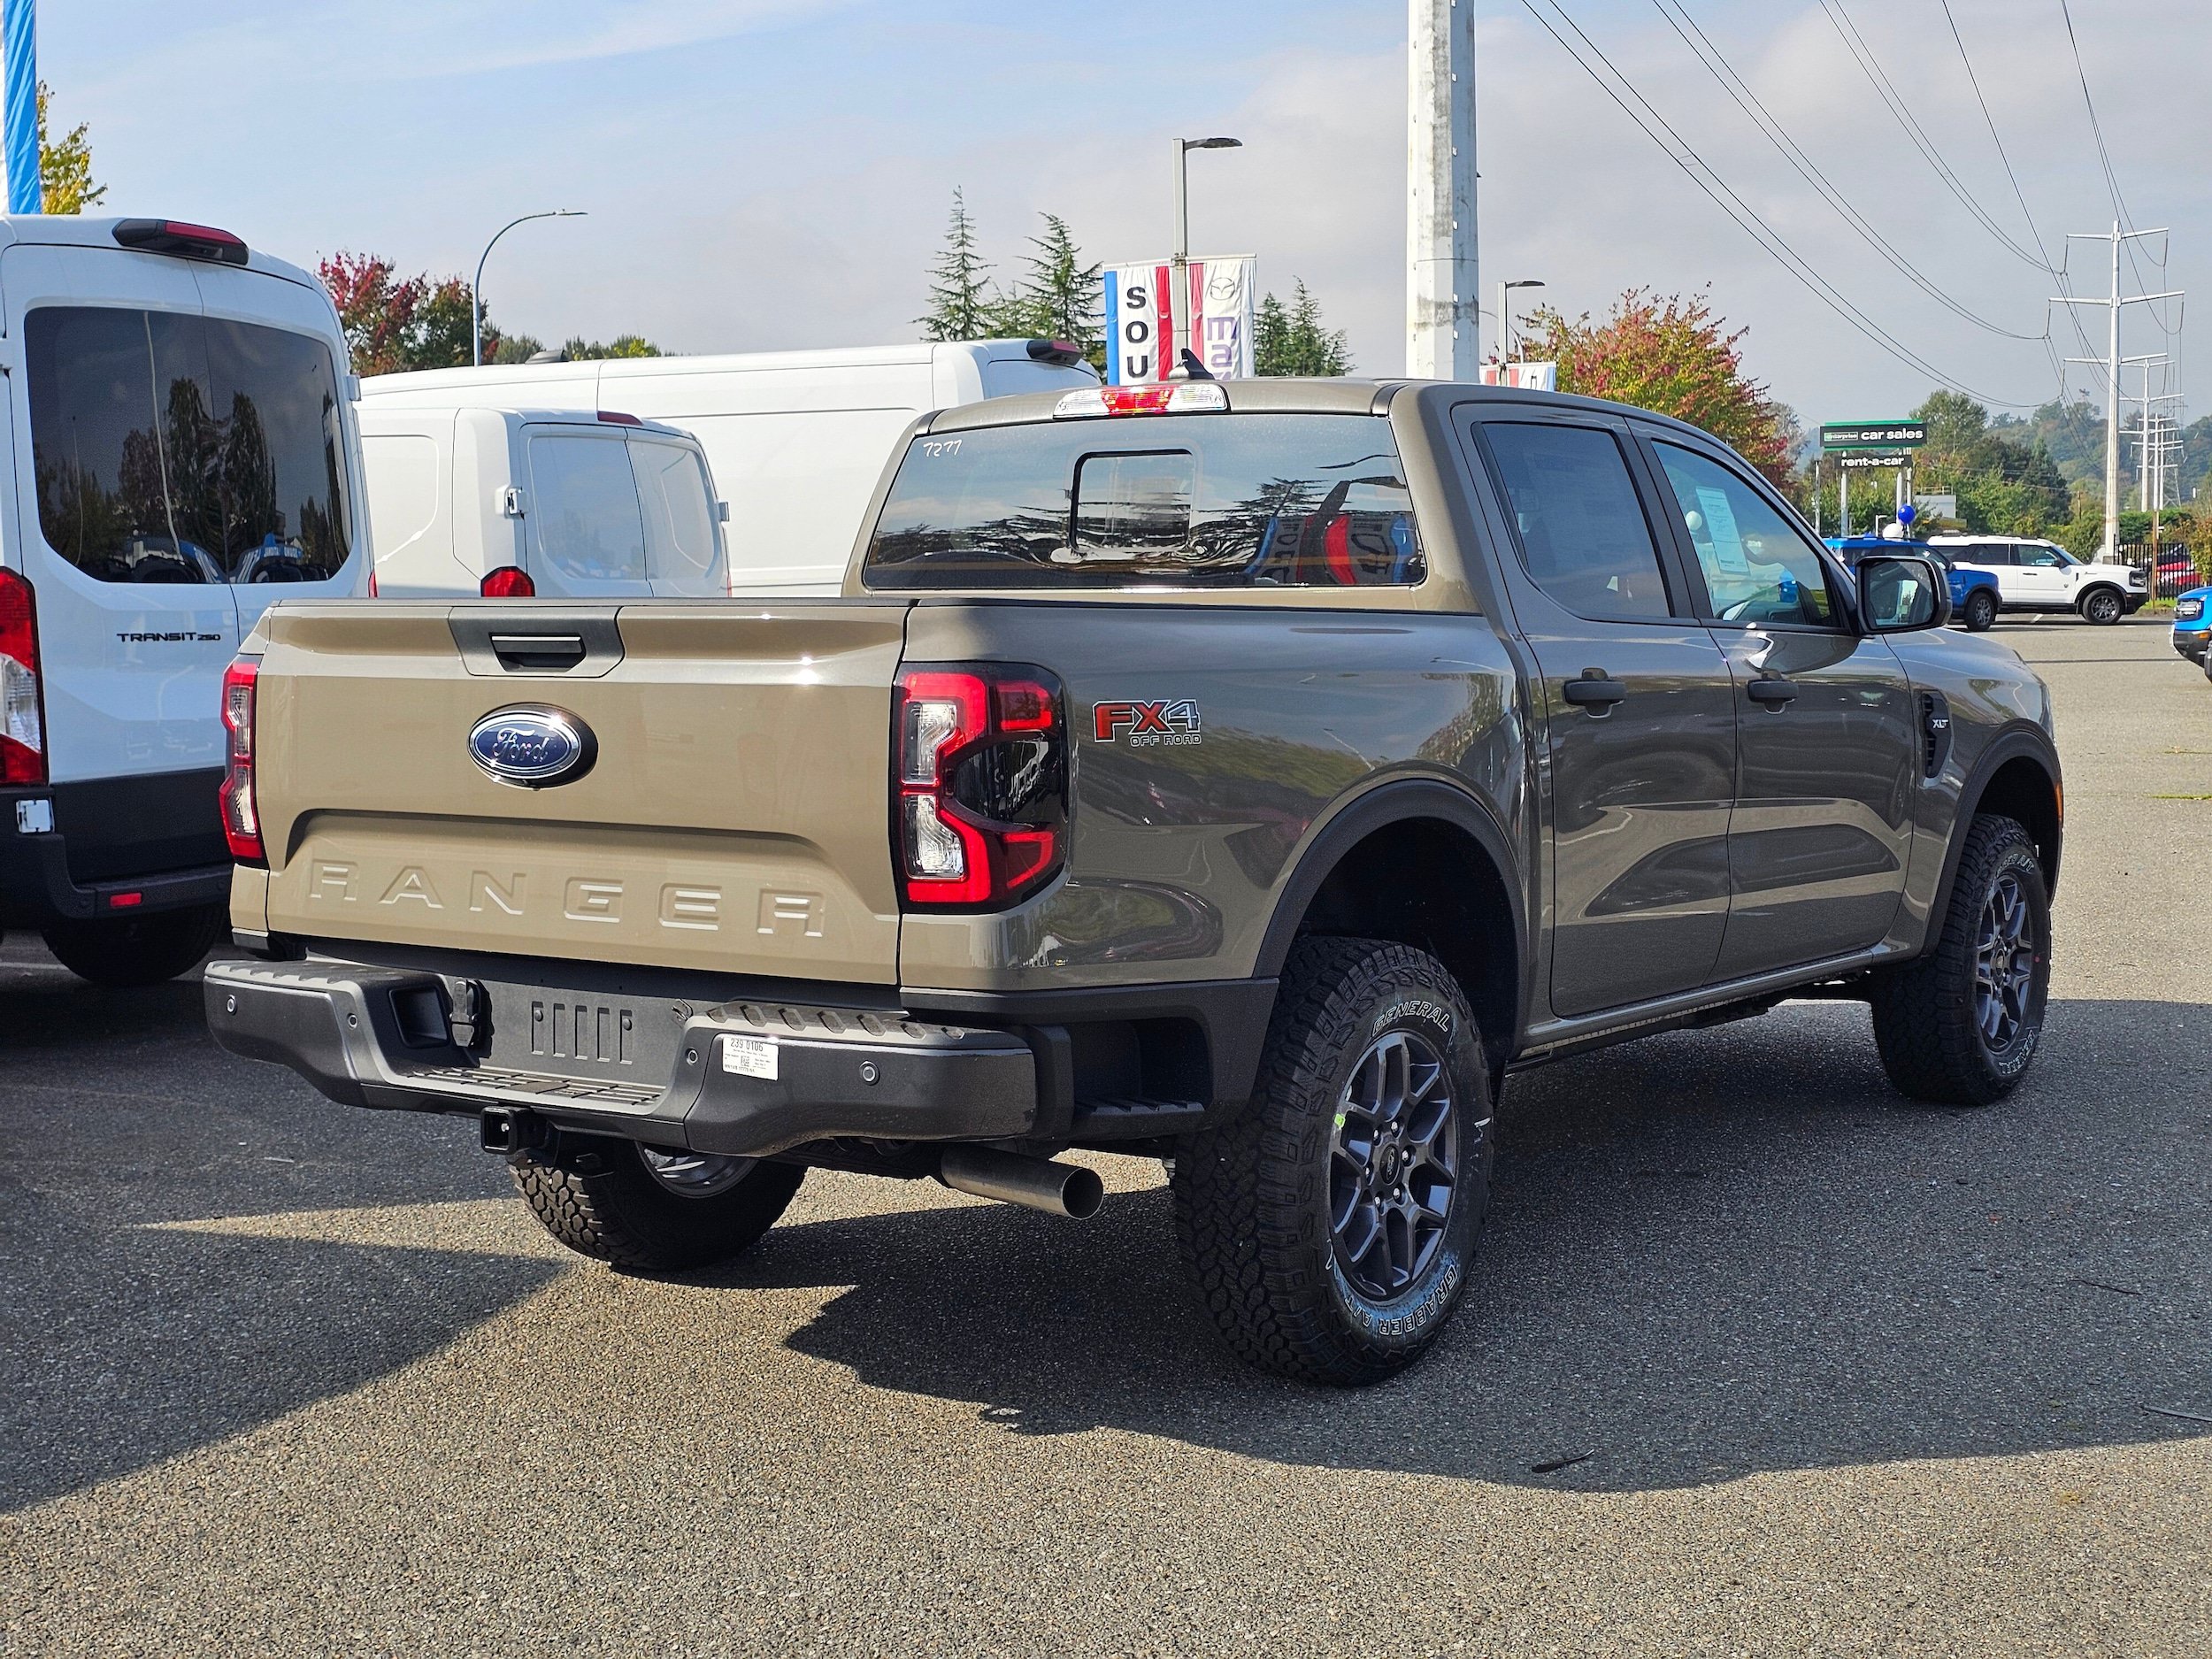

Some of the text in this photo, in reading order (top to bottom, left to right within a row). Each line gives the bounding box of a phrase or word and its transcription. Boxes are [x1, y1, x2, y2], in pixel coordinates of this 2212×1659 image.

[1861, 431, 1885, 441] car
[1886, 427, 1924, 440] sales
[923, 439, 962, 457] 7277
[1841, 457, 1904, 467] rent-a-car
[116, 632, 196, 642] TRANSIT
[1092, 699, 1201, 742] FX4
[1932, 718, 1949, 729] XLT
[492, 727, 550, 762] Ford
[1130, 733, 1202, 747] OFF ROAD
[310, 858, 825, 938] RANGER
[1371, 1000, 1450, 1033] GENERAL
[730, 1037, 764, 1052] 239 0106
[1344, 1263, 1458, 1335] GRABBER A/T
